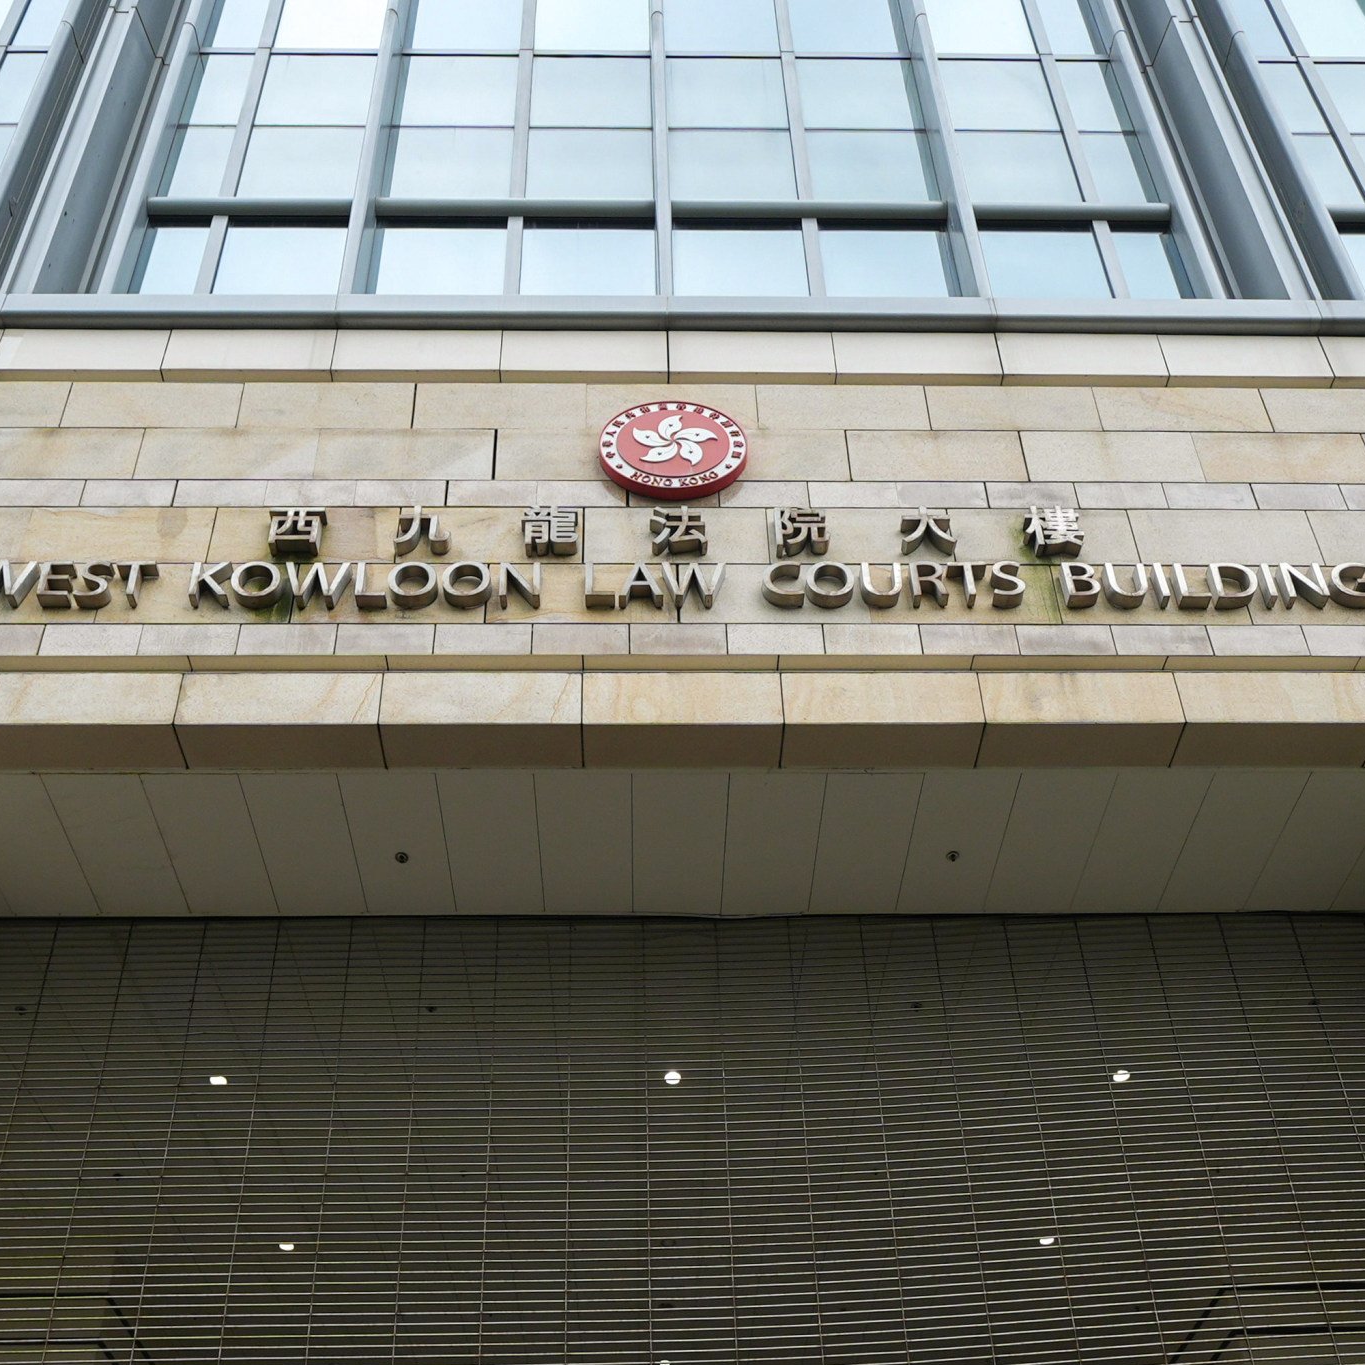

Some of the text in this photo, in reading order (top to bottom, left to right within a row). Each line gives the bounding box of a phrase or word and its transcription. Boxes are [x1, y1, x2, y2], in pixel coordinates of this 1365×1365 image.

[630, 471, 719, 487] HONG KONG
[268, 504, 1085, 558] 西九龍法院大樓
[188, 560, 542, 610] KOWLOON
[584, 560, 727, 609] LAW
[761, 560, 1027, 609] COURTS
